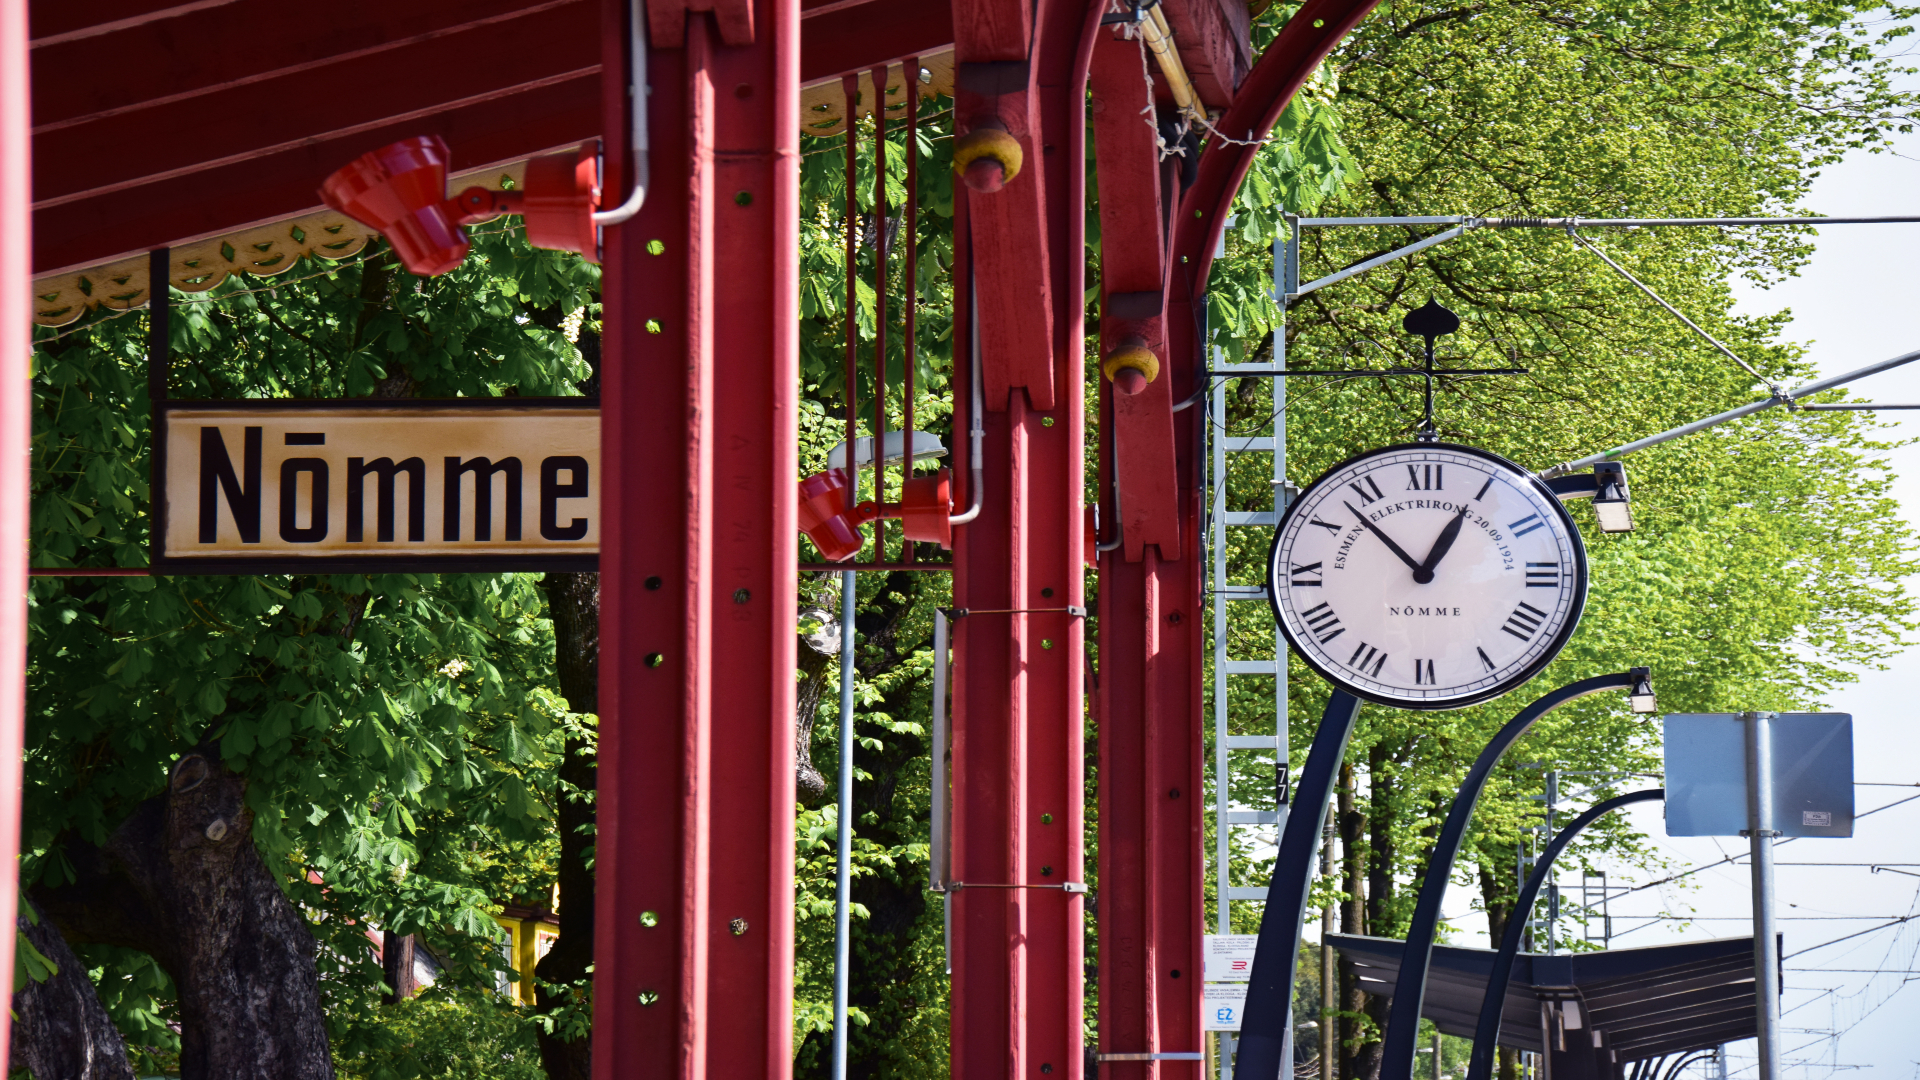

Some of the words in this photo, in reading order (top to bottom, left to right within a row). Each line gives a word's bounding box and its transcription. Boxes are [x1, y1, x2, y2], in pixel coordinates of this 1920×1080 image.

[1406, 464, 1444, 491] XII
[1309, 514, 1342, 537] X
[1333, 521, 1368, 570] ESIMEN
[1369, 500, 1474, 523] ELEKTRIRONG
[1473, 516, 1515, 571] 20.09.1924
[1508, 513, 1547, 539] II
[1389, 604, 1462, 617] NÕMME
[1477, 646, 1498, 673] V
